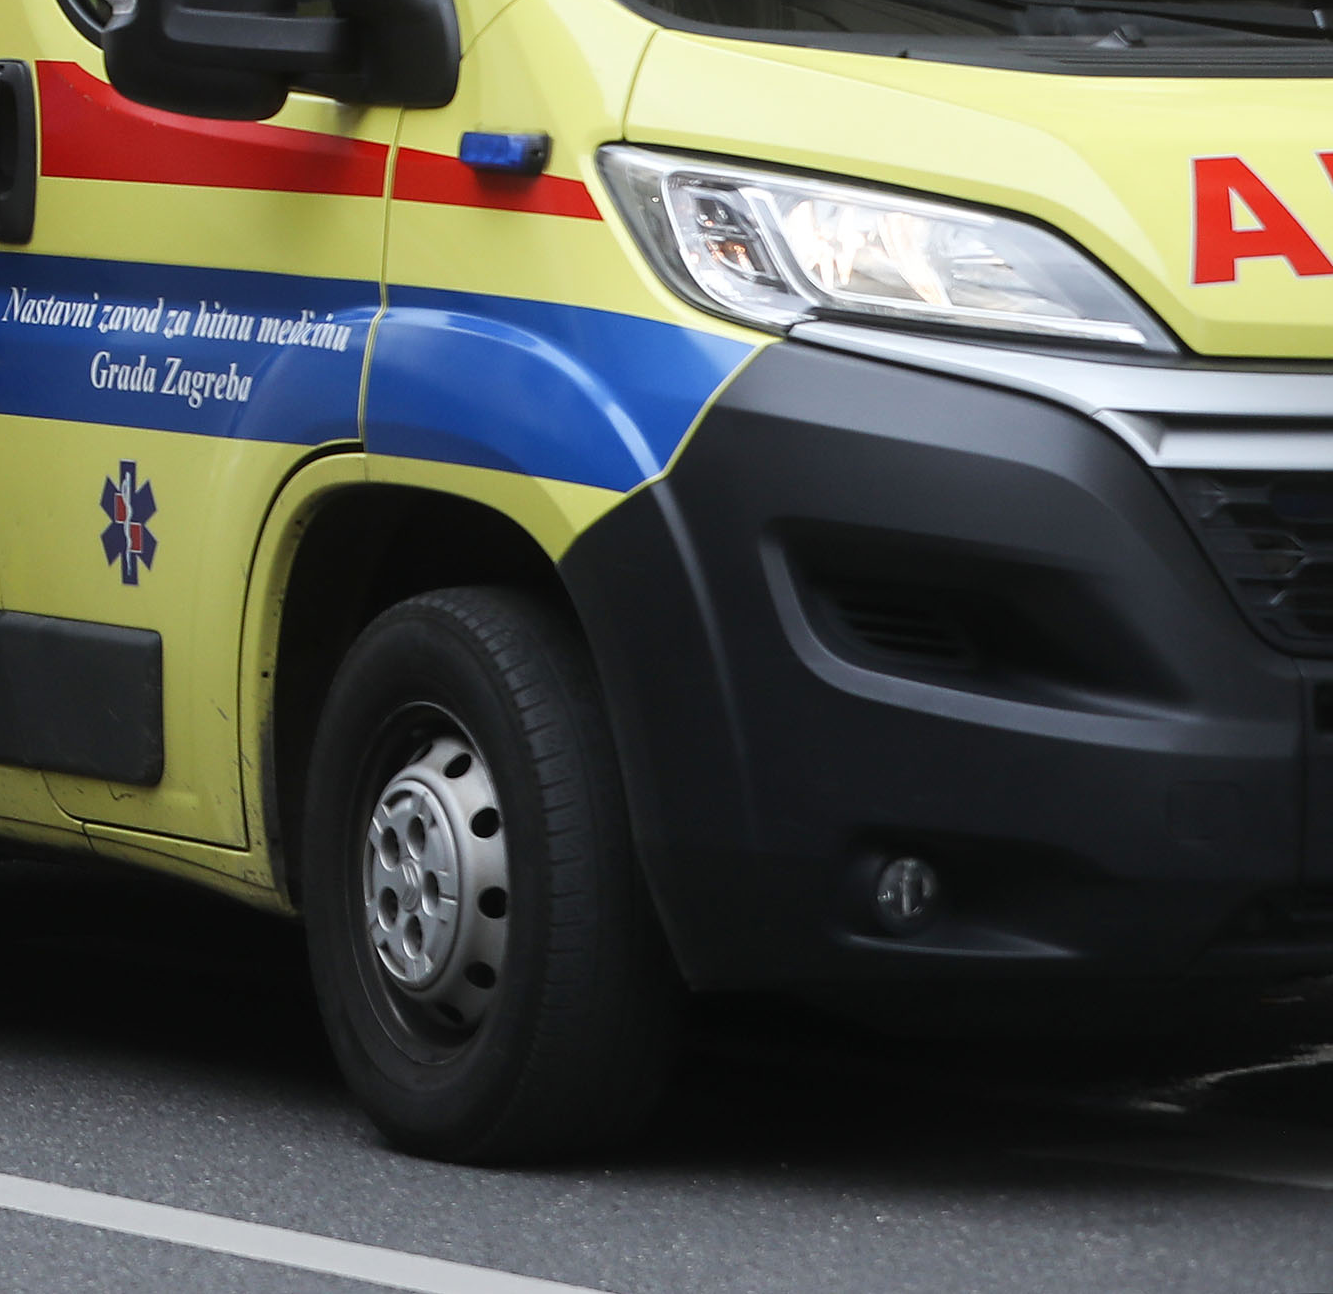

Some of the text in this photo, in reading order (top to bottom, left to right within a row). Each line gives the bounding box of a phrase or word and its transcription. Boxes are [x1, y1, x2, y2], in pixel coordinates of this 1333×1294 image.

[1190, 149, 1333, 286] A
[1, 287, 353, 352] Nastavni zavod za hitnu medicinu
[90, 351, 253, 409] Grada Zagreba
